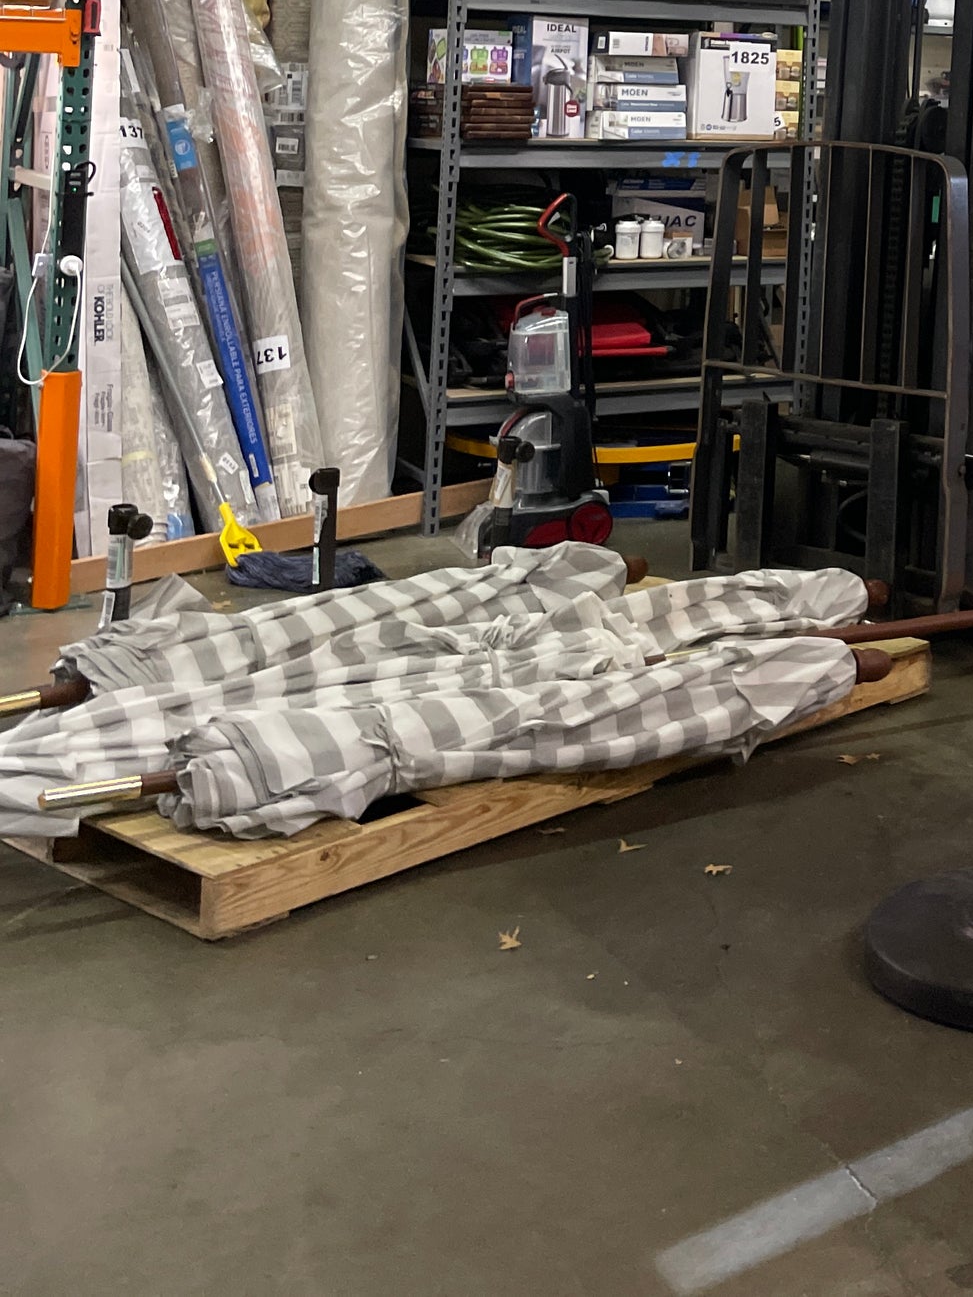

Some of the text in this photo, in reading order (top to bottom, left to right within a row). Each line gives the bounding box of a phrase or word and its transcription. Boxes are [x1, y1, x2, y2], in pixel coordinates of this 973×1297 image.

[546, 23, 577, 33] IDEAL
[731, 51, 770, 65] 1825
[233, 368, 245, 392] PARA
